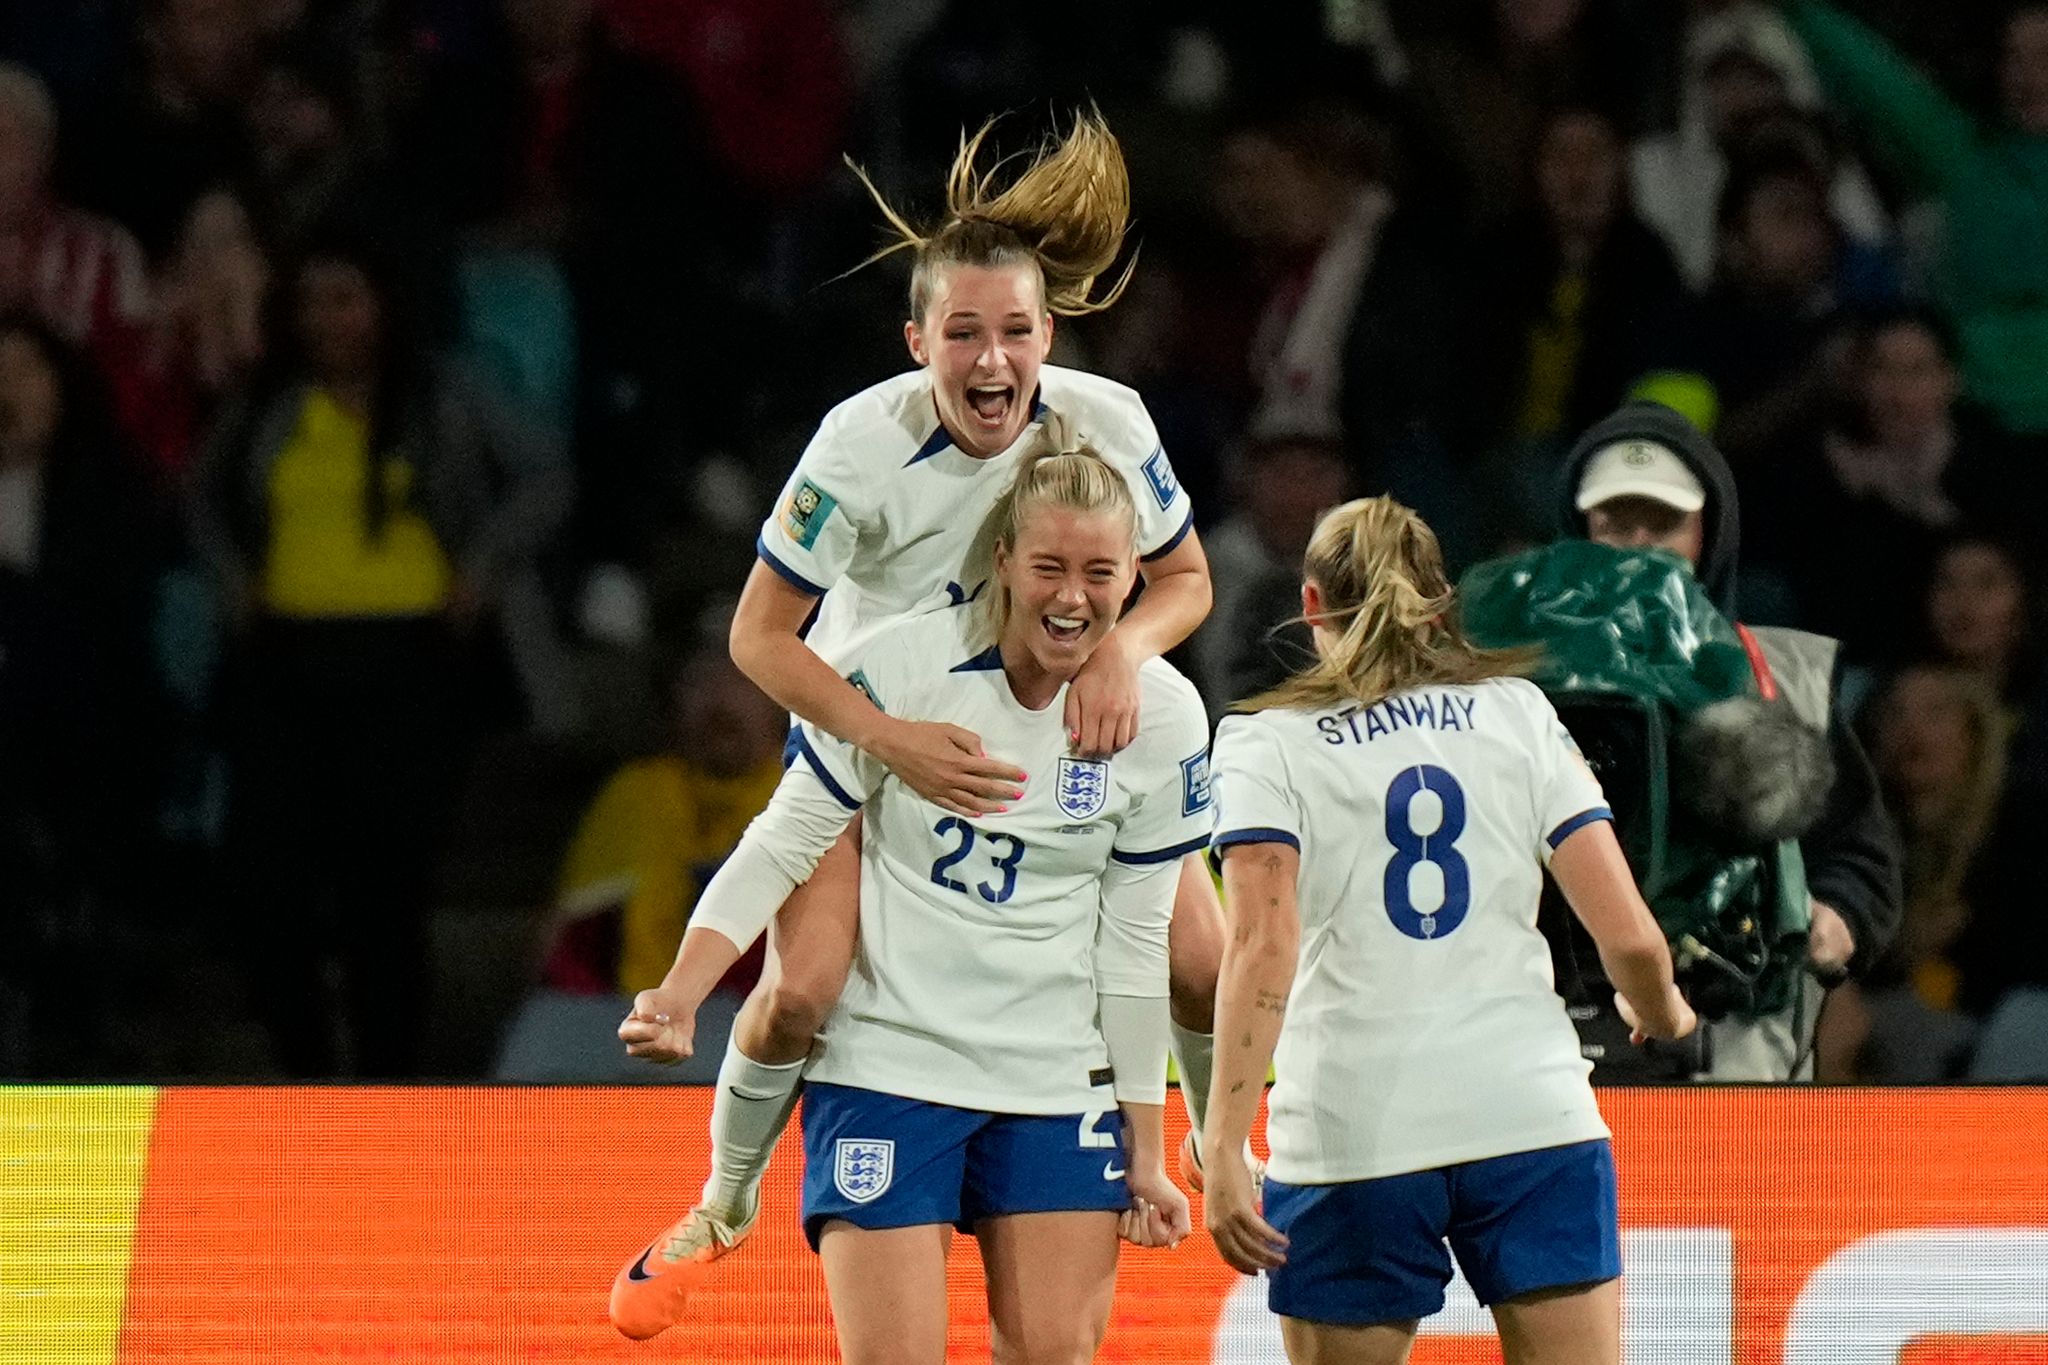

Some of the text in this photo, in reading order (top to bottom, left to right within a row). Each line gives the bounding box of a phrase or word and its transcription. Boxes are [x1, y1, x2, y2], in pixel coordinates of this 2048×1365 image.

[1316, 693, 1476, 745] STANWAY
[931, 816, 1026, 904] 23
[1383, 764, 1471, 940] 8
